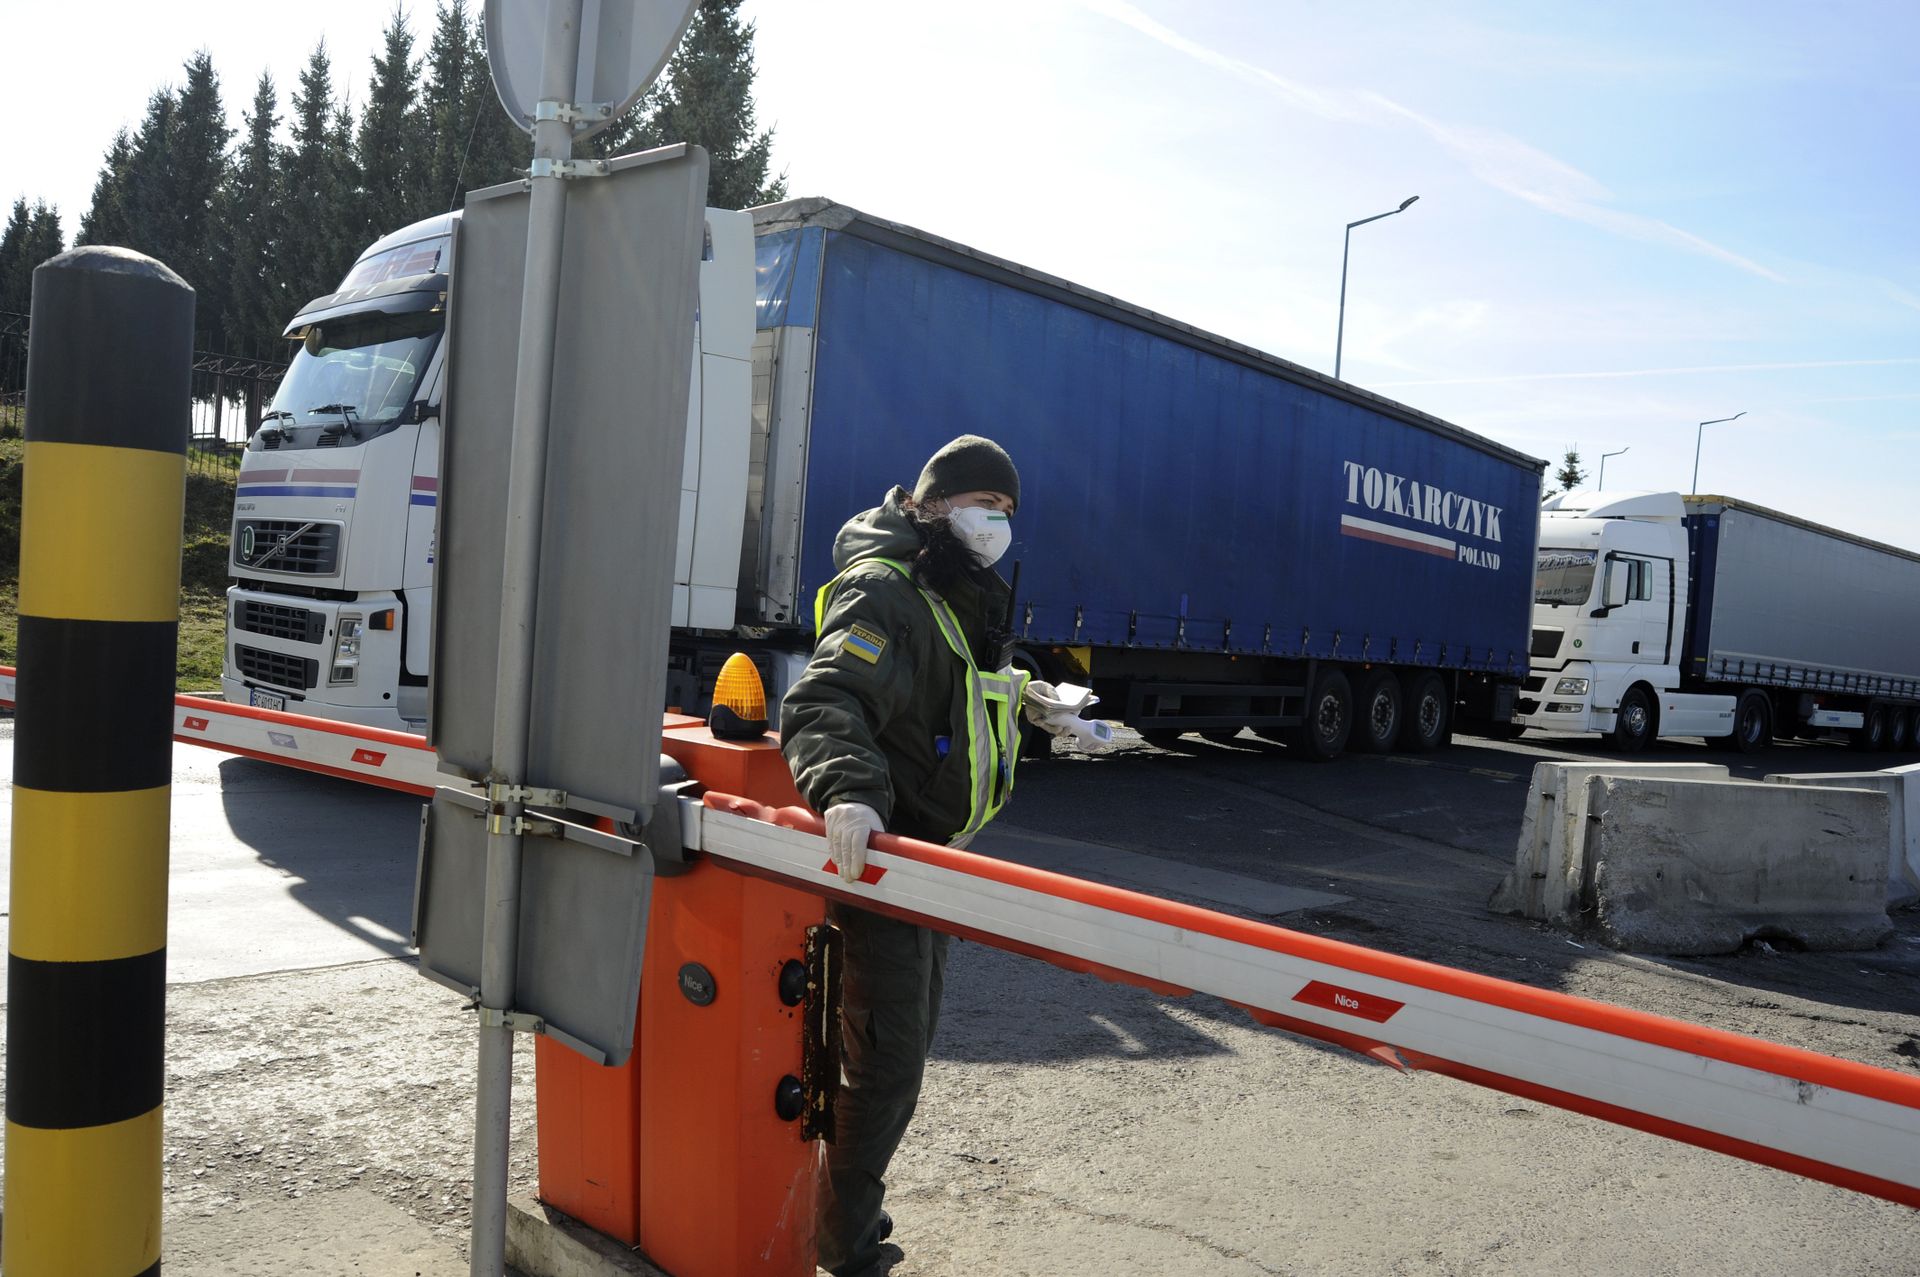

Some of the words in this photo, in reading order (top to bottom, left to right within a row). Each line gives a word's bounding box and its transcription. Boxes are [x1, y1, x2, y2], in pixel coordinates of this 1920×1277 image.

[1343, 460, 1503, 542] TOKARCZYK
[1458, 545, 1500, 570] POLAND
[852, 626, 883, 648] УКРАЇНА
[684, 974, 703, 992] Nice
[1334, 993, 1359, 1009] Nice
